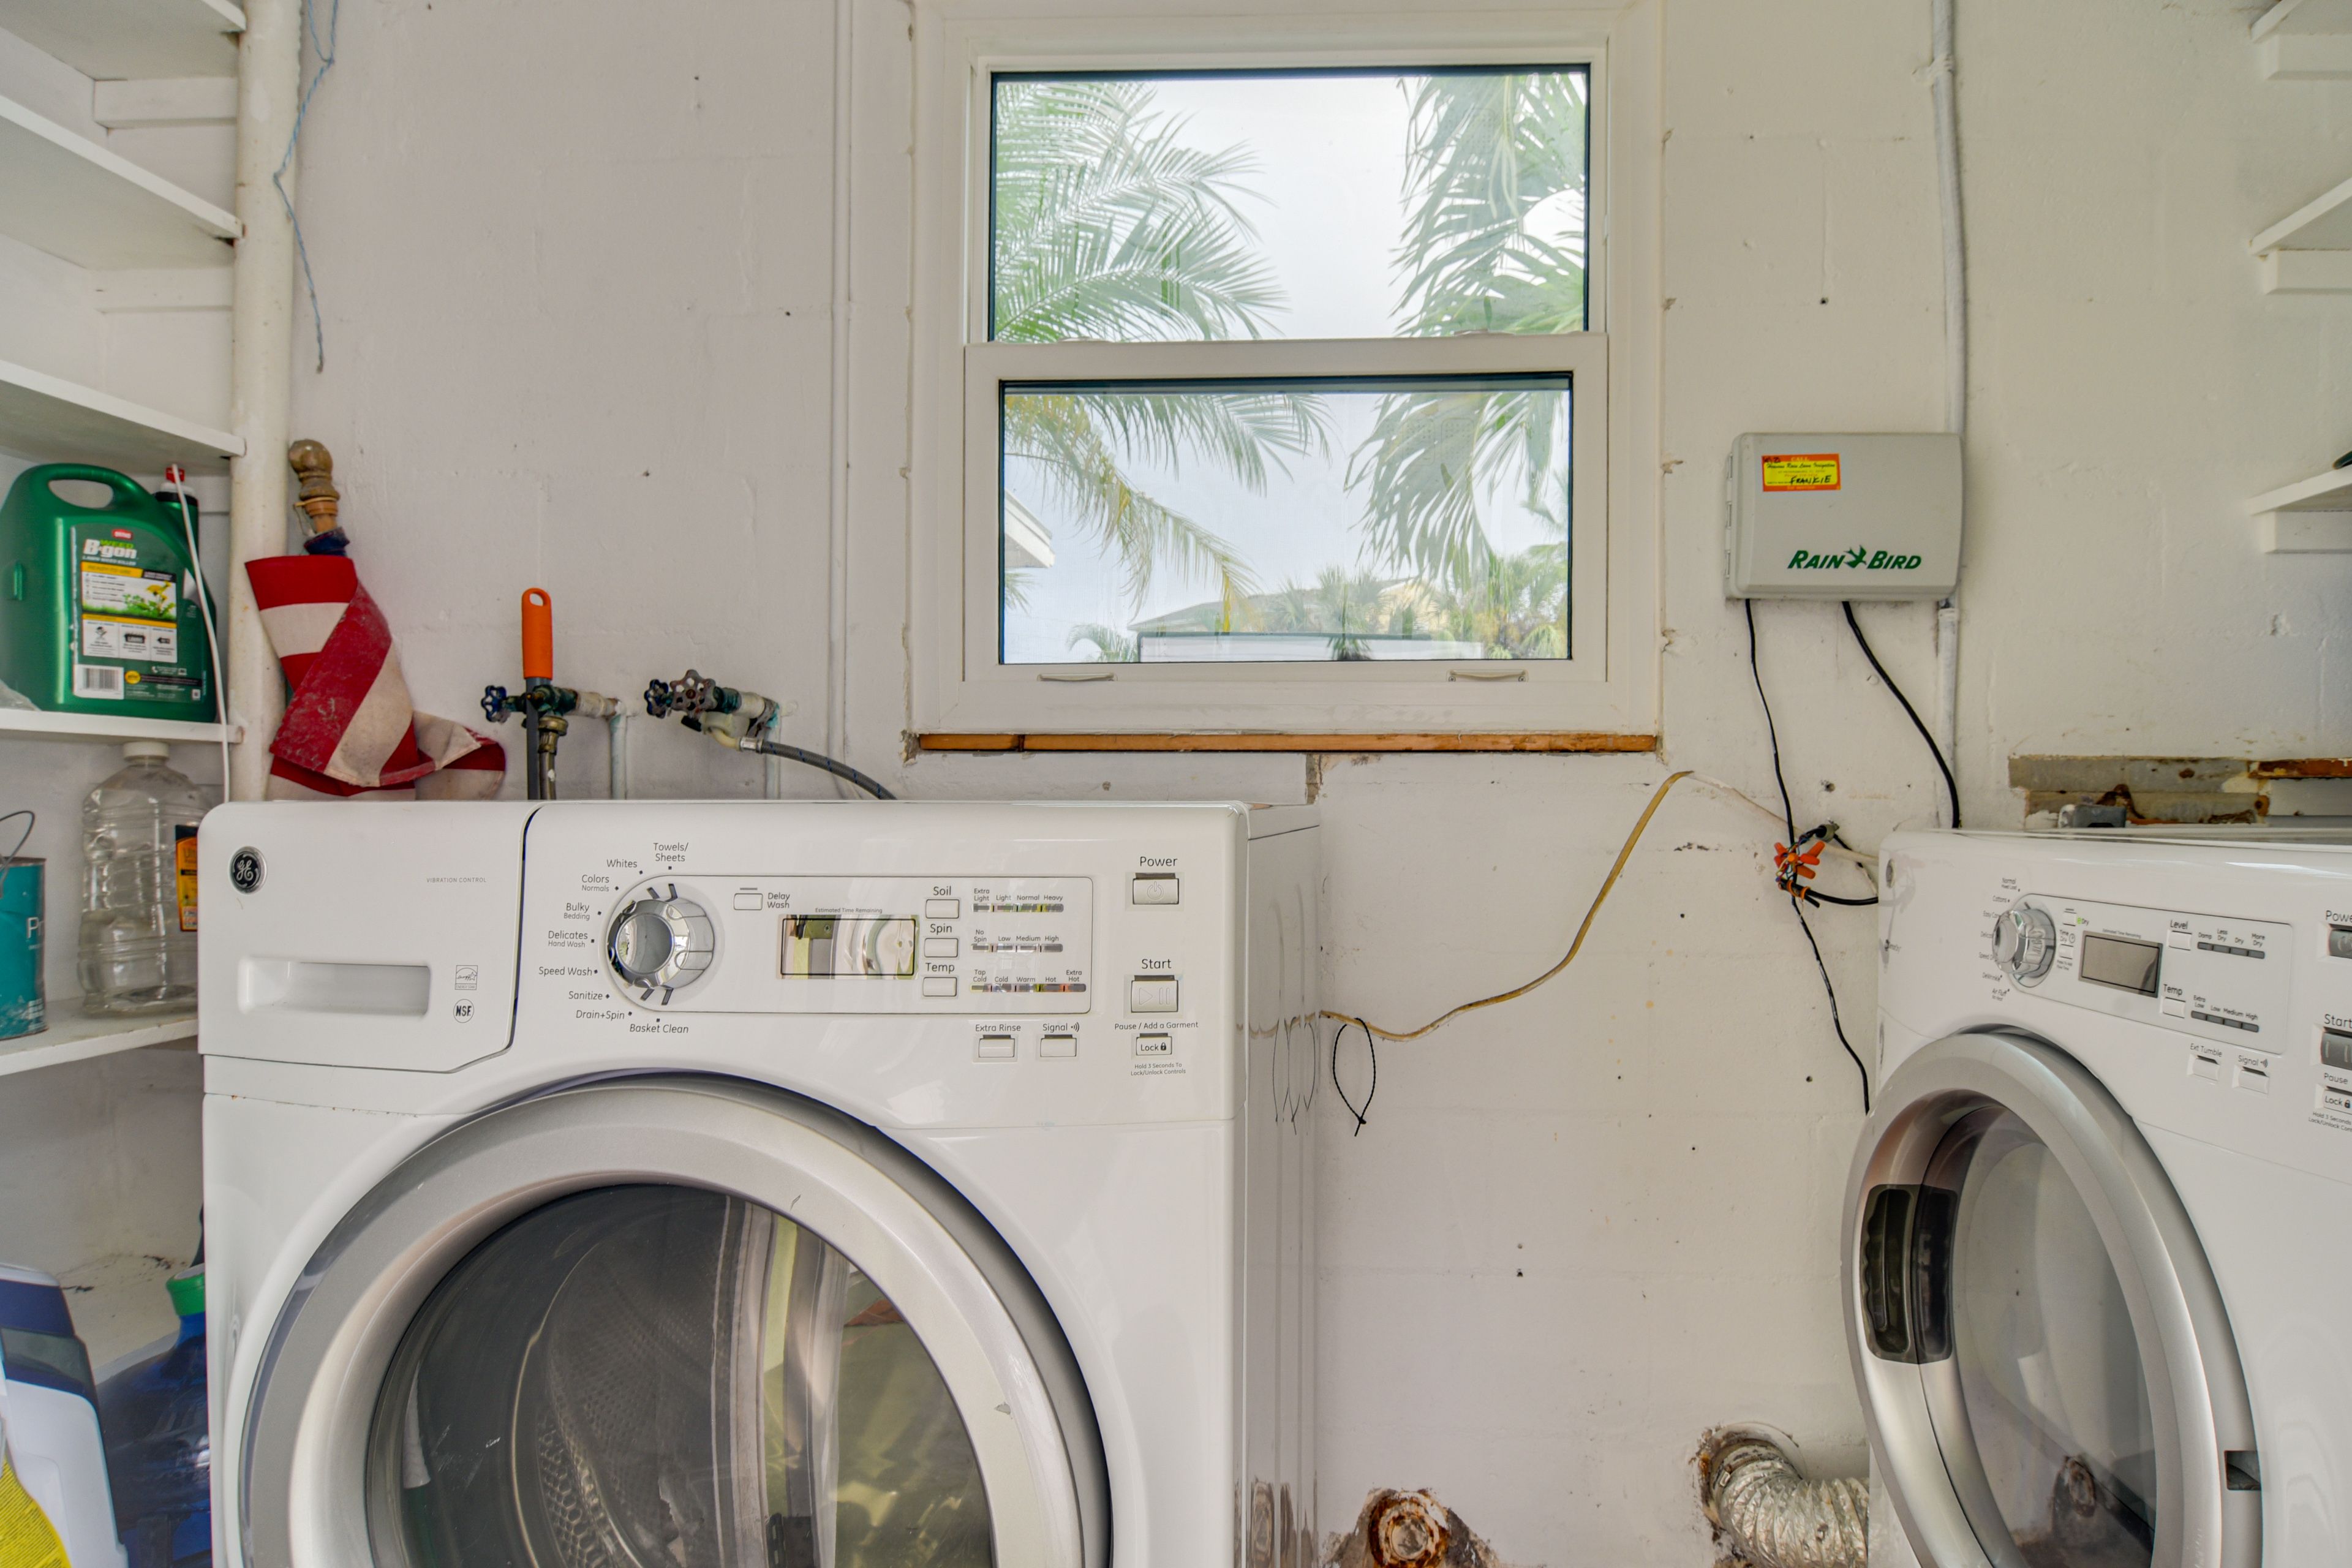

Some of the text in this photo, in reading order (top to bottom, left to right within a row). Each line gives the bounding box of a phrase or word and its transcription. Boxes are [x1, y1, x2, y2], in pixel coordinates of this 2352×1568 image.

[1790, 475, 1832, 485] FRANKIE
[1787, 550, 1921, 569] RAIN BIRD
[654, 842, 688, 852] Towels/
[655, 853, 685, 862] Sheets
[1140, 856, 1178, 867] Power
[606, 859, 638, 868] Whites
[581, 875, 609, 883] Colors
[933, 886, 951, 896] Soil
[767, 892, 790, 901] Delay
[566, 903, 589, 913] Bulky
[930, 923, 952, 934] Spin
[2170, 920, 2188, 930] Level
[548, 930, 588, 940] Delicates
[926, 963, 955, 973] Temp
[1141, 959, 1172, 970] Start
[538, 966, 592, 977] Speed Wash
[2163, 984, 2183, 996] Temp
[568, 991, 603, 1000] Sanitize
[456, 1005, 472, 1017] NSF
[576, 1010, 625, 1021] Drain+Spin
[2223, 1008, 2244, 1017] Medium
[630, 1024, 688, 1033] Basket Clean
[975, 1023, 997, 1032] Extra
[1042, 1023, 1068, 1033] Signal
[2190, 1043, 2222, 1057] Ext Tumble
[2238, 1055, 2259, 1067] Signal
[2324, 1072, 2348, 1085] Pause
[2324, 1095, 2342, 1106] Lock
